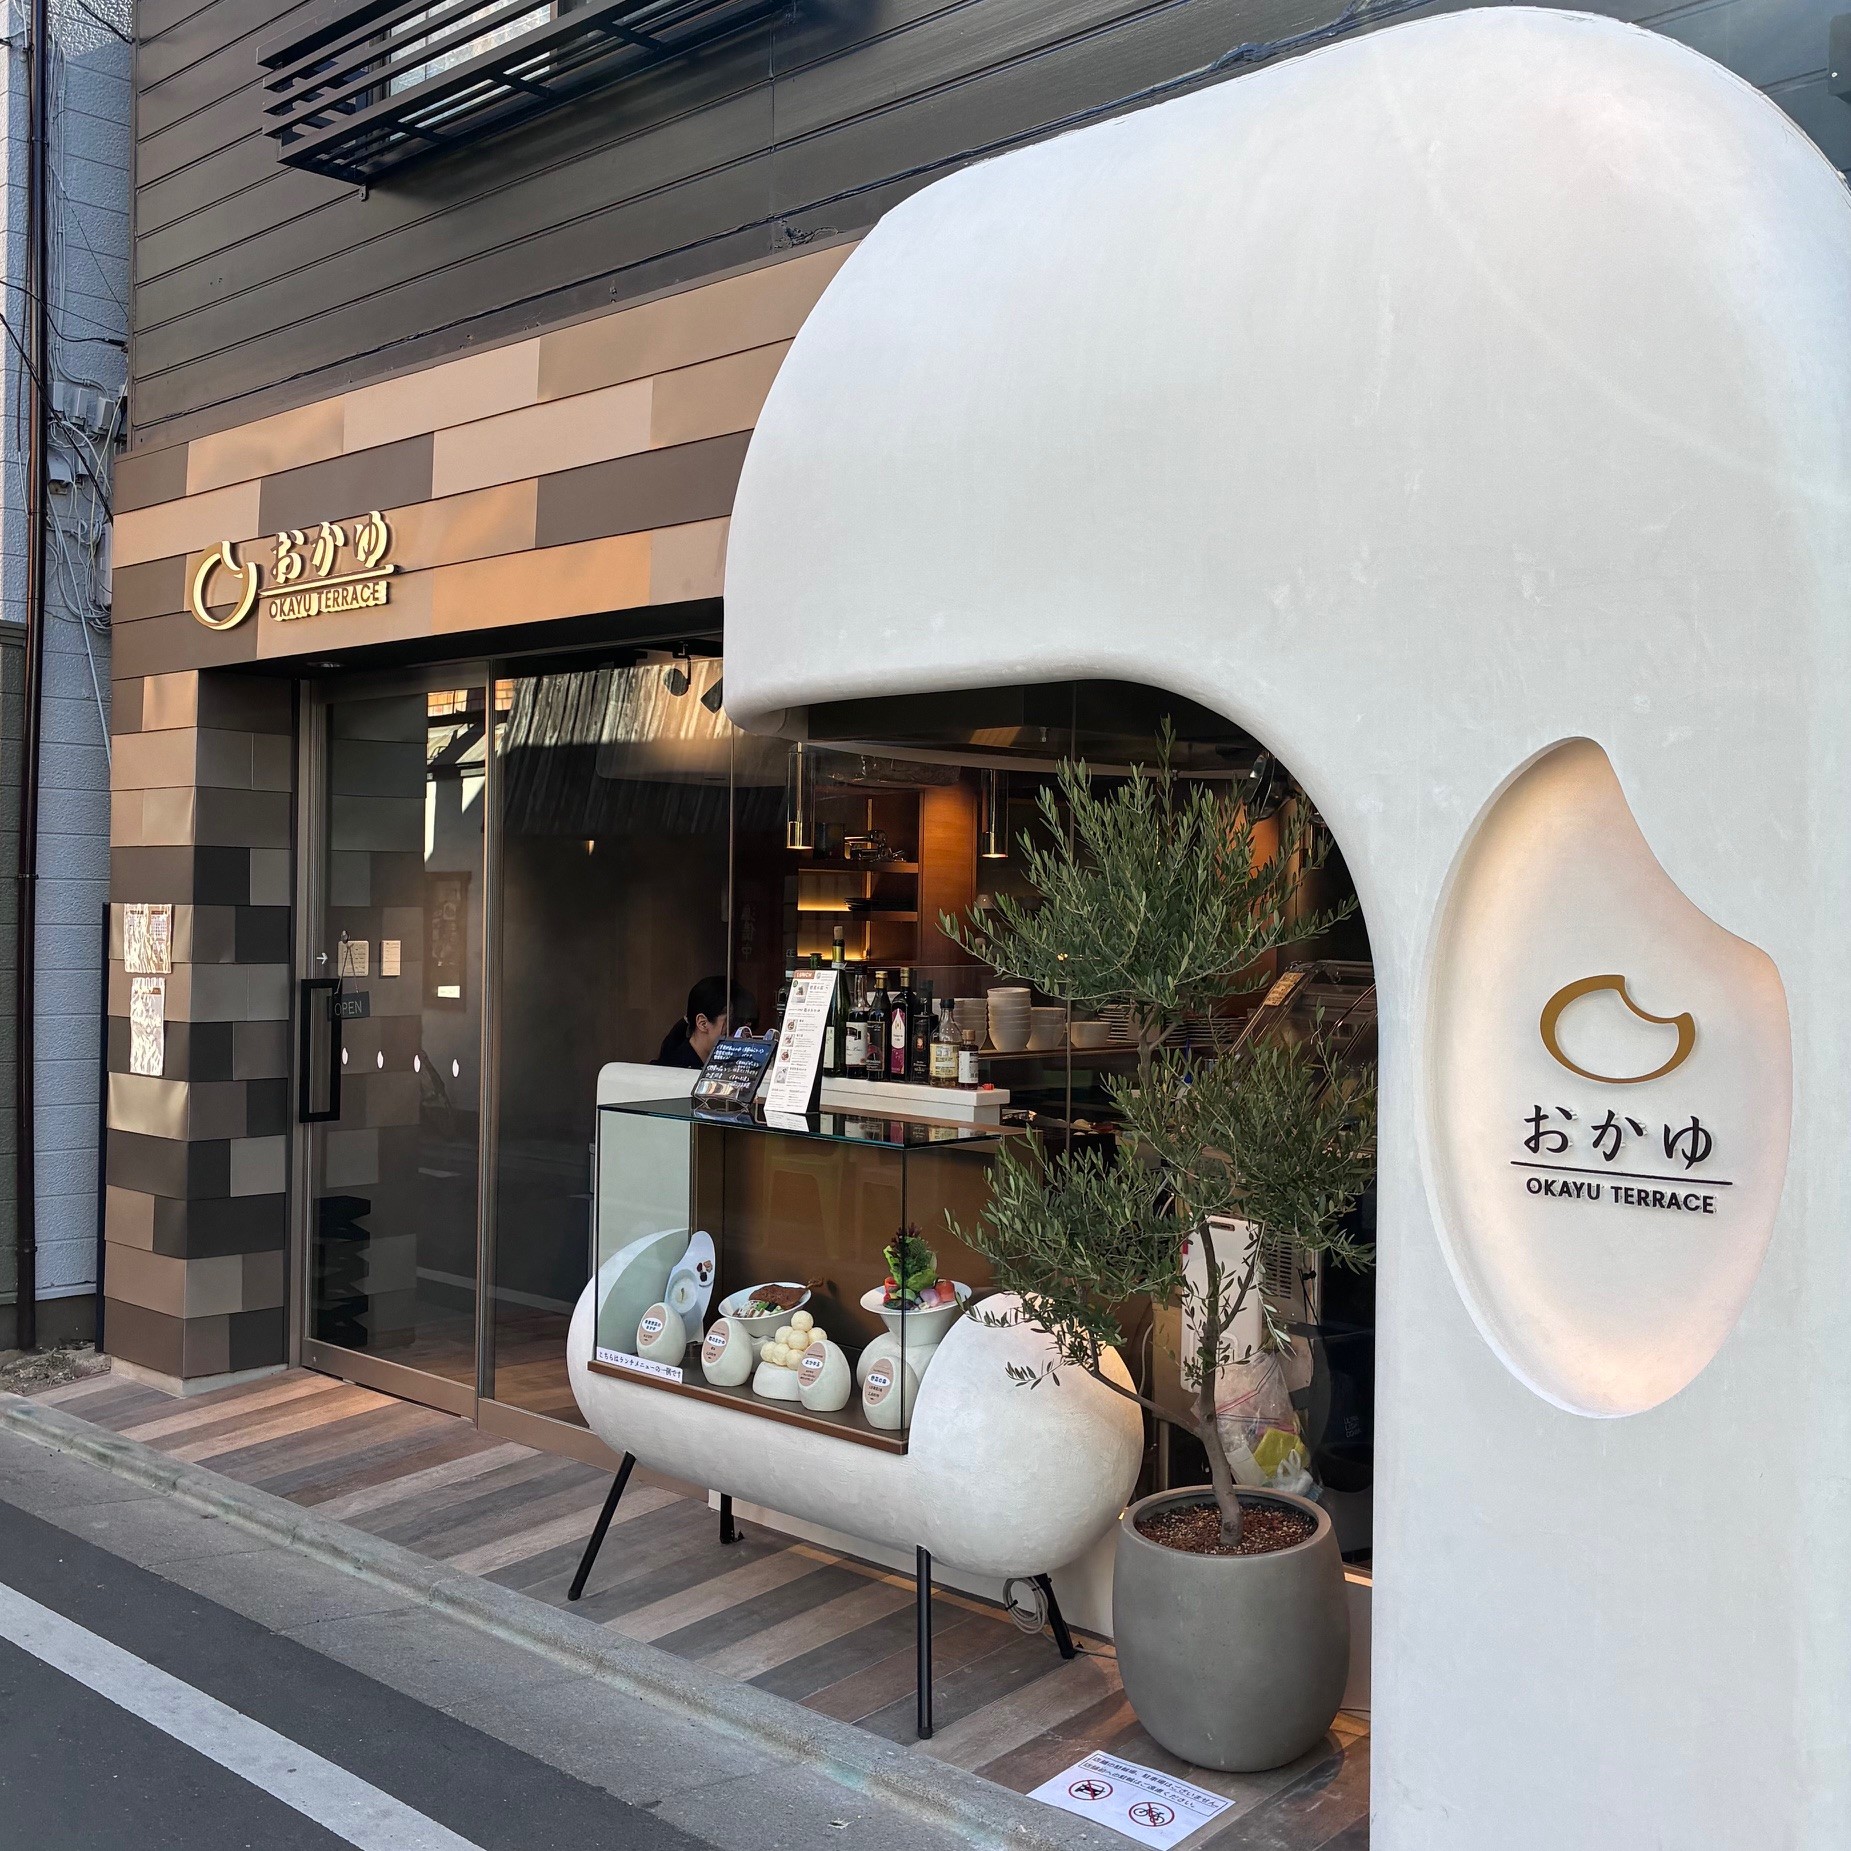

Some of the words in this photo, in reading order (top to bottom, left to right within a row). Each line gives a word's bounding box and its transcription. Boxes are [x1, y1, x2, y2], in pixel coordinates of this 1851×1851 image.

[271, 510, 387, 583] おかゆ
[269, 592, 319, 621] OKAYU
[318, 581, 387, 613] TERRACE
[334, 1000, 362, 1017] OPEN
[1523, 1104, 1713, 1170] おかゆ
[1526, 1177, 1600, 1201] OKAYU
[1610, 1185, 1717, 1214] TERRACE
